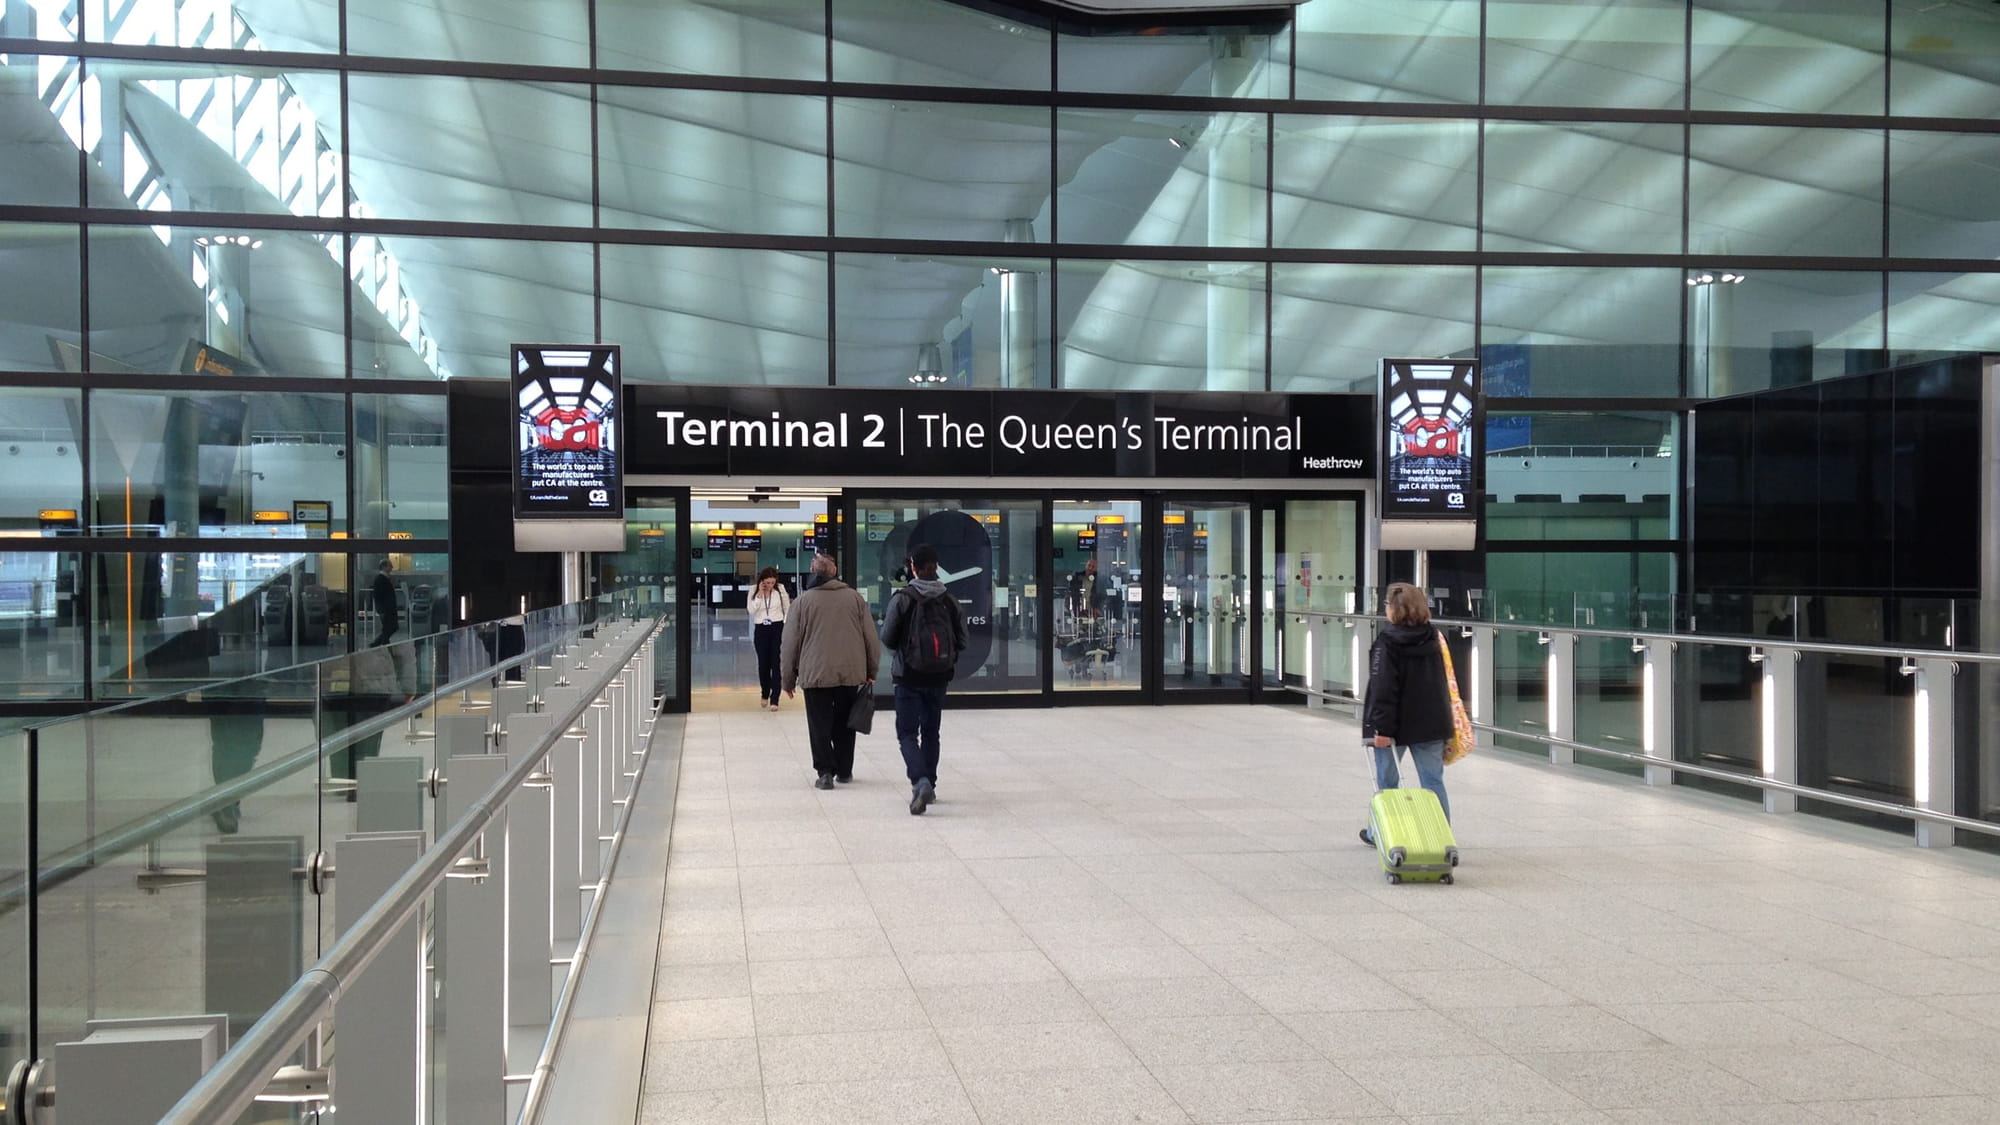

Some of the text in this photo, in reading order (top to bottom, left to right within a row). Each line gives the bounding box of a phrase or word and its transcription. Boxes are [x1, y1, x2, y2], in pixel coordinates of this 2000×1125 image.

[657, 411, 1301, 454] Terminal 2 The Queen’s Terminal
[1303, 456, 1363, 469] Heathrow
[532, 463, 546, 471] The
[547, 463, 572, 471] world's
[574, 464, 586, 473] top
[1435, 469, 1446, 477] top
[542, 471, 594, 479] manufacturers
[1408, 475, 1453, 483] manufacturers
[532, 480, 544, 488] put
[588, 489, 608, 502] ca
[1447, 492, 1464, 504] ca
